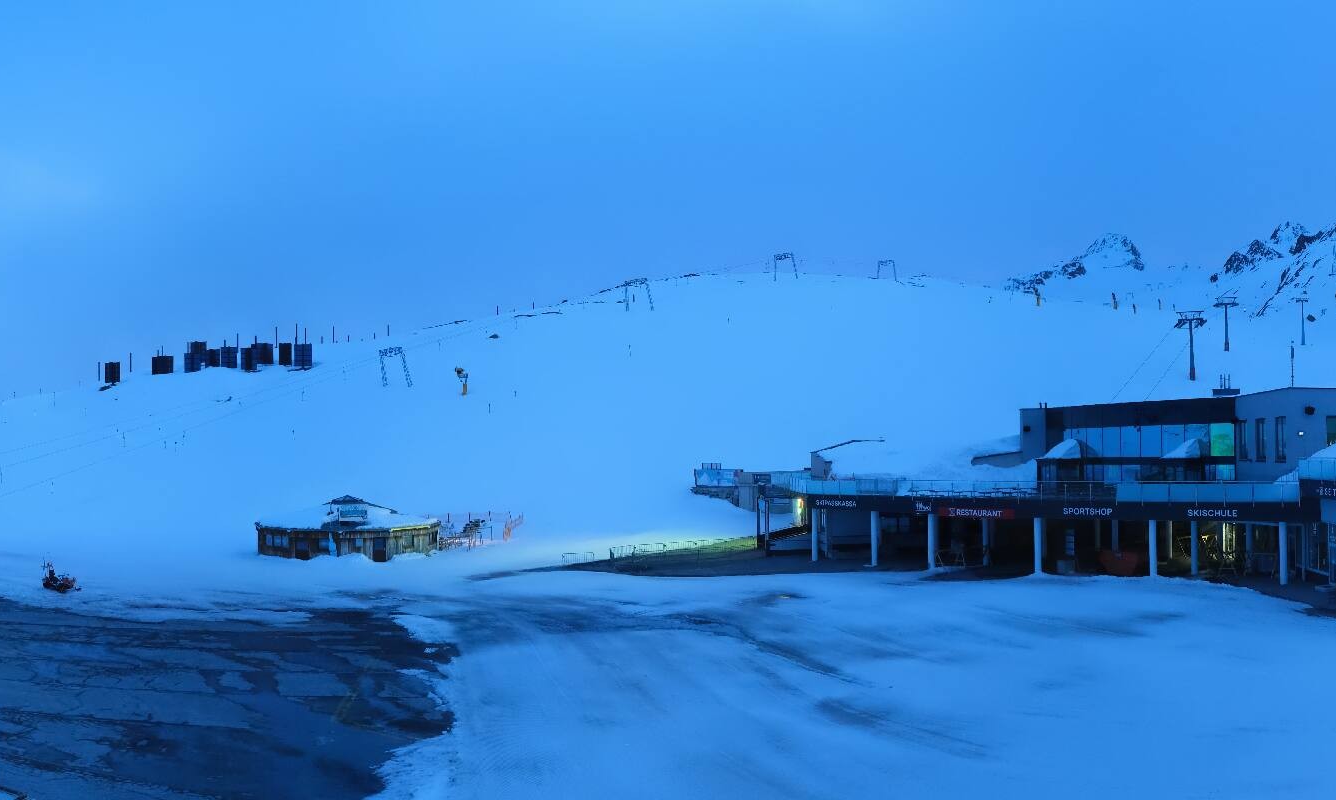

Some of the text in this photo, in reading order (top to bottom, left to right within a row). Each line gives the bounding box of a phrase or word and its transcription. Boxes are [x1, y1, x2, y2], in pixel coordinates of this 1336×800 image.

[956, 508, 1003, 517] RESTAURANT
[1063, 507, 1113, 516] SPORTSHOP
[1187, 509, 1238, 517] SKISCHULE
